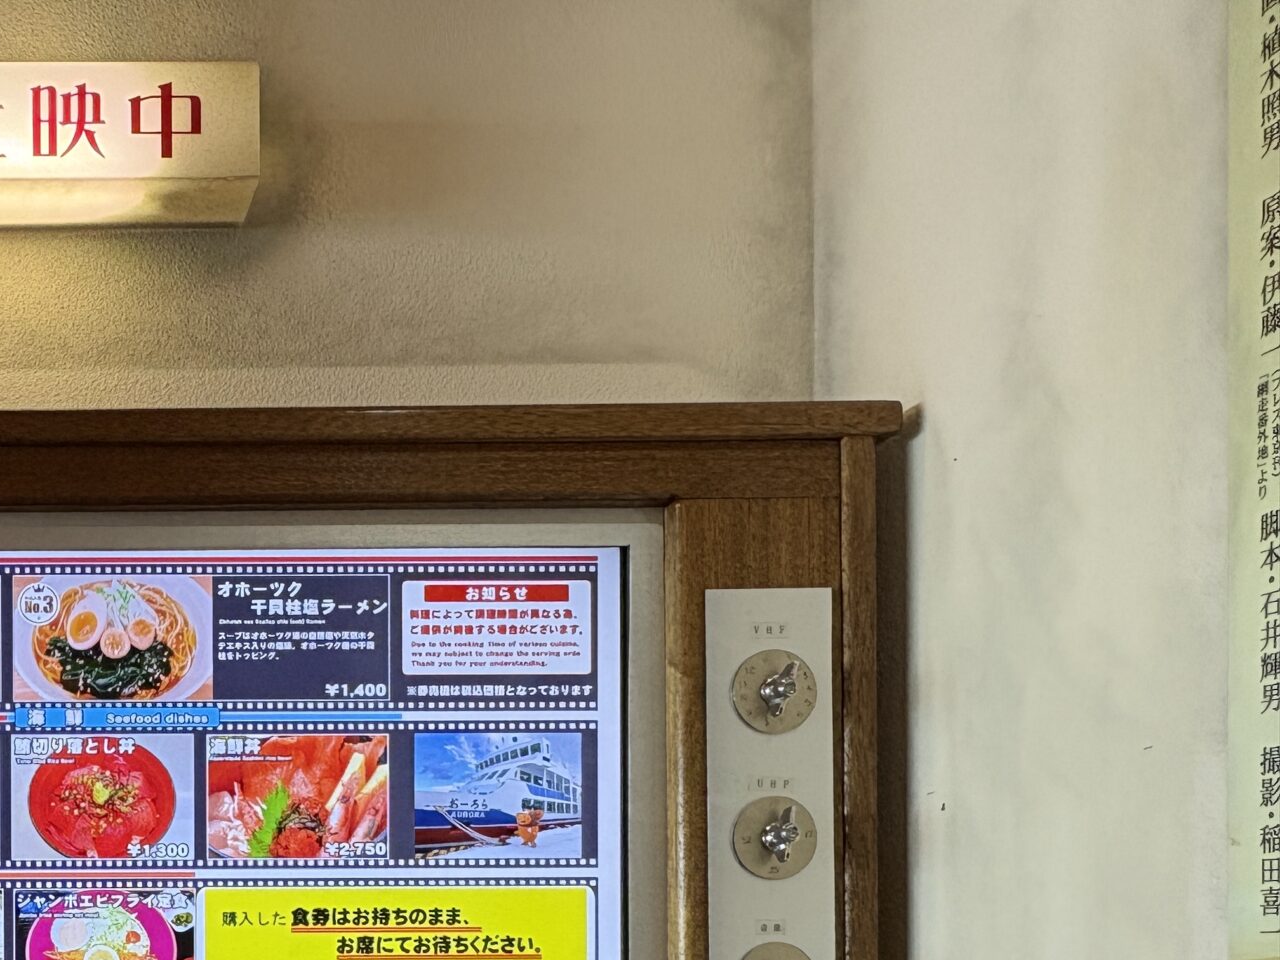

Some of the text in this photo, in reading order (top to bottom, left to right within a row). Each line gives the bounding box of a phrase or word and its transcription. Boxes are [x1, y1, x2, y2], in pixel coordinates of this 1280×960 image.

[217, 581, 302, 597] オホーツク
[465, 587, 529, 601] お知らせ
[25, 595, 54, 614] No.3
[251, 599, 388, 616] 干貝柱塩ラーメン
[325, 683, 387, 698] ¥1,400
[106, 713, 209, 725] Seafood dishes
[127, 843, 190, 858] ¥1,300
[325, 842, 387, 856] ¥2,750
[17, 894, 189, 909] ジャンボエビフライ定食
[336, 936, 542, 955] お席にてお待ちください。
